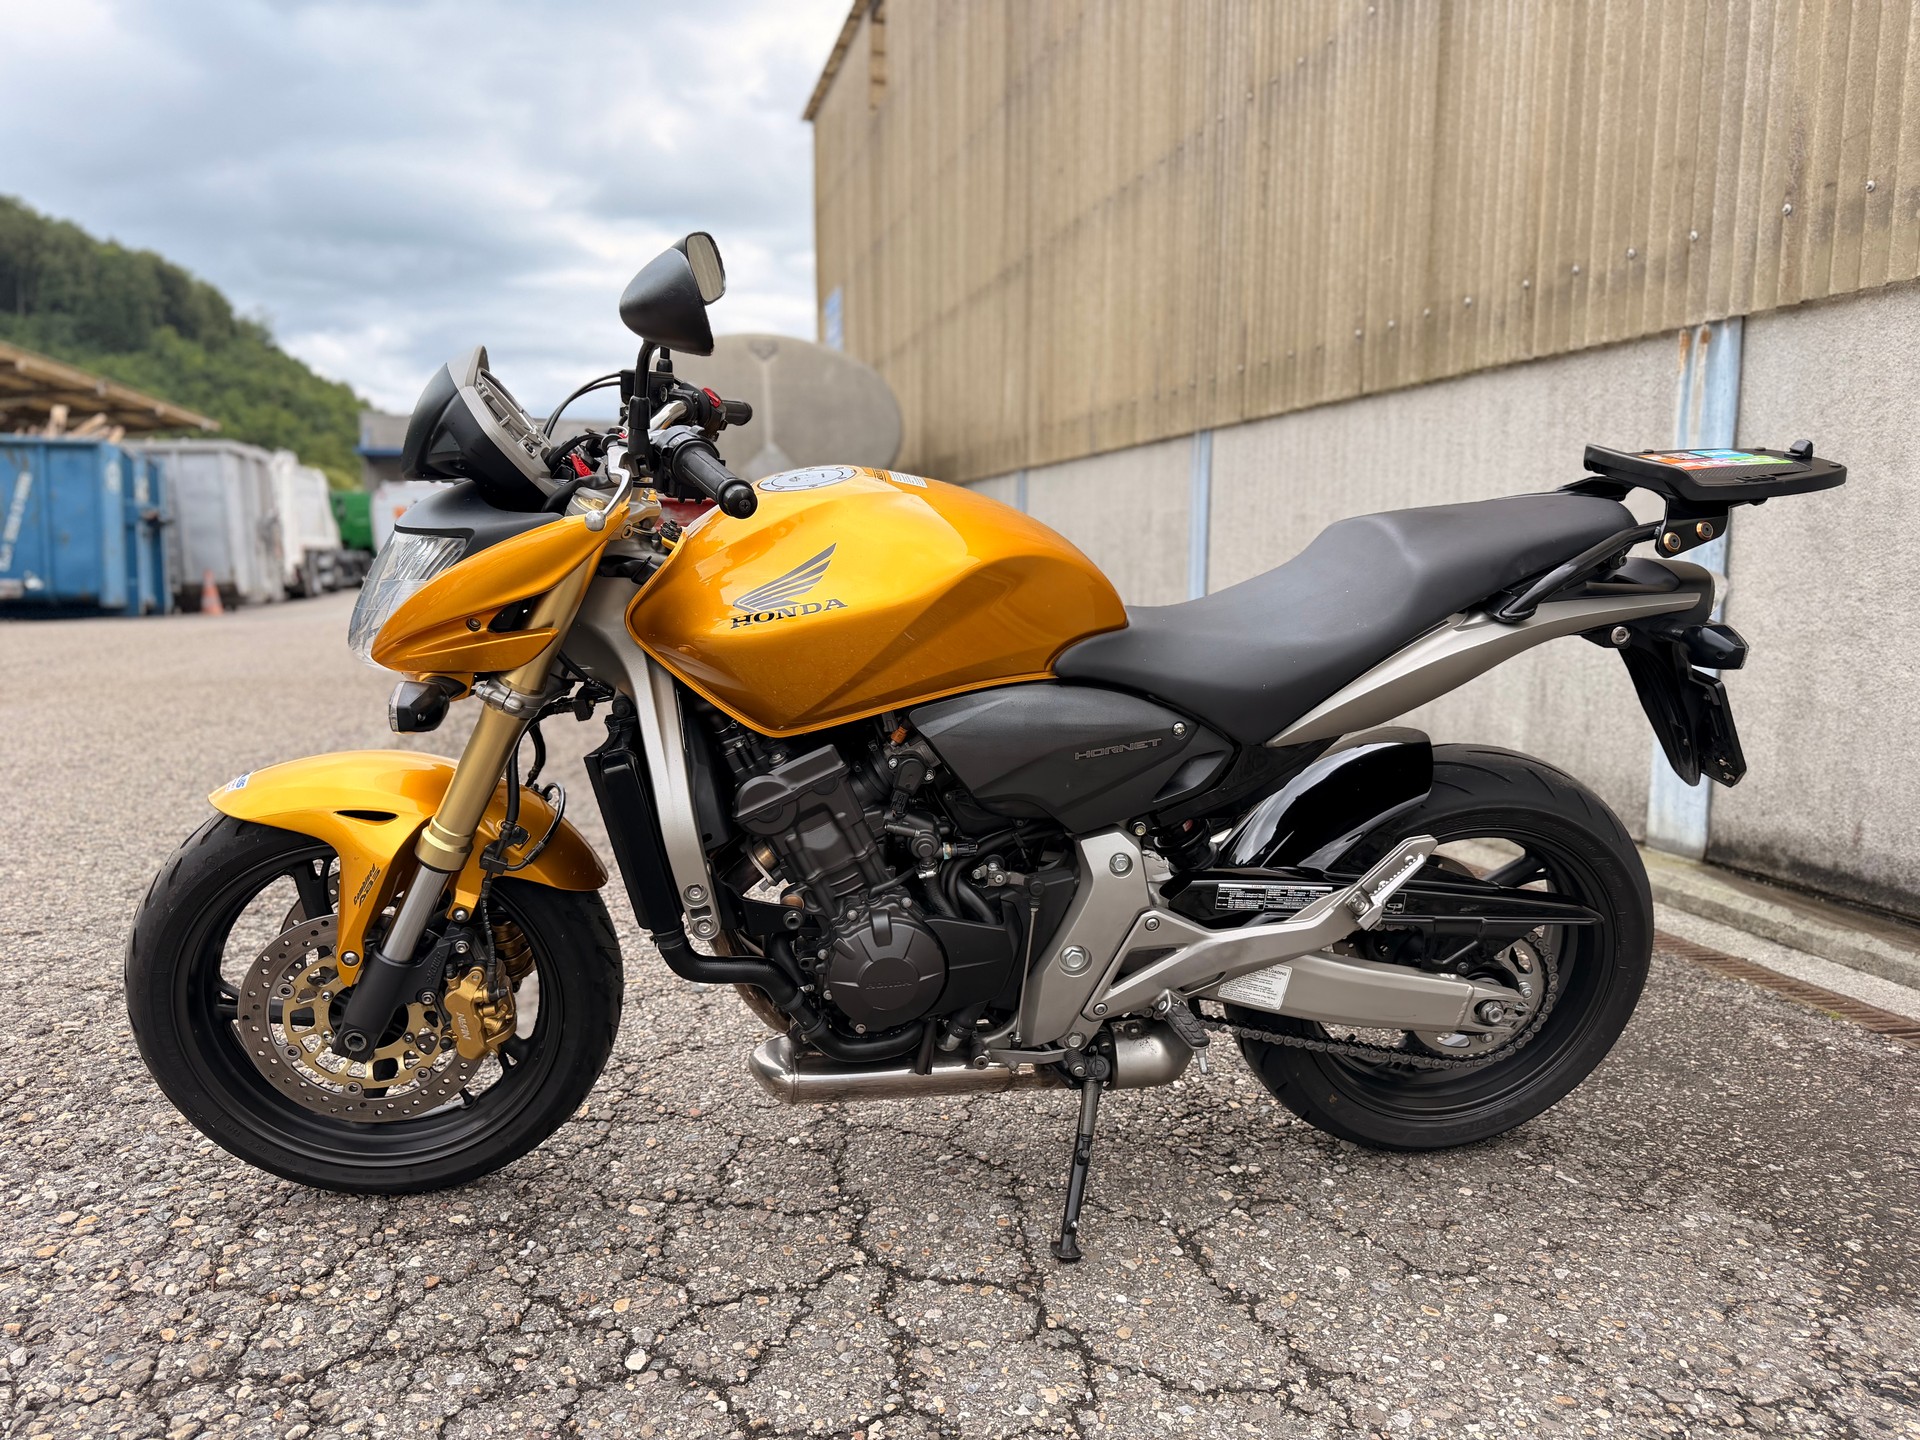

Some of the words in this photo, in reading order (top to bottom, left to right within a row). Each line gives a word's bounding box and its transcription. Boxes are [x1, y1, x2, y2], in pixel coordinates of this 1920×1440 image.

[731, 598, 848, 629] HONDA
[1074, 738, 1162, 760] HORNET
[353, 862, 376, 905] Combined
